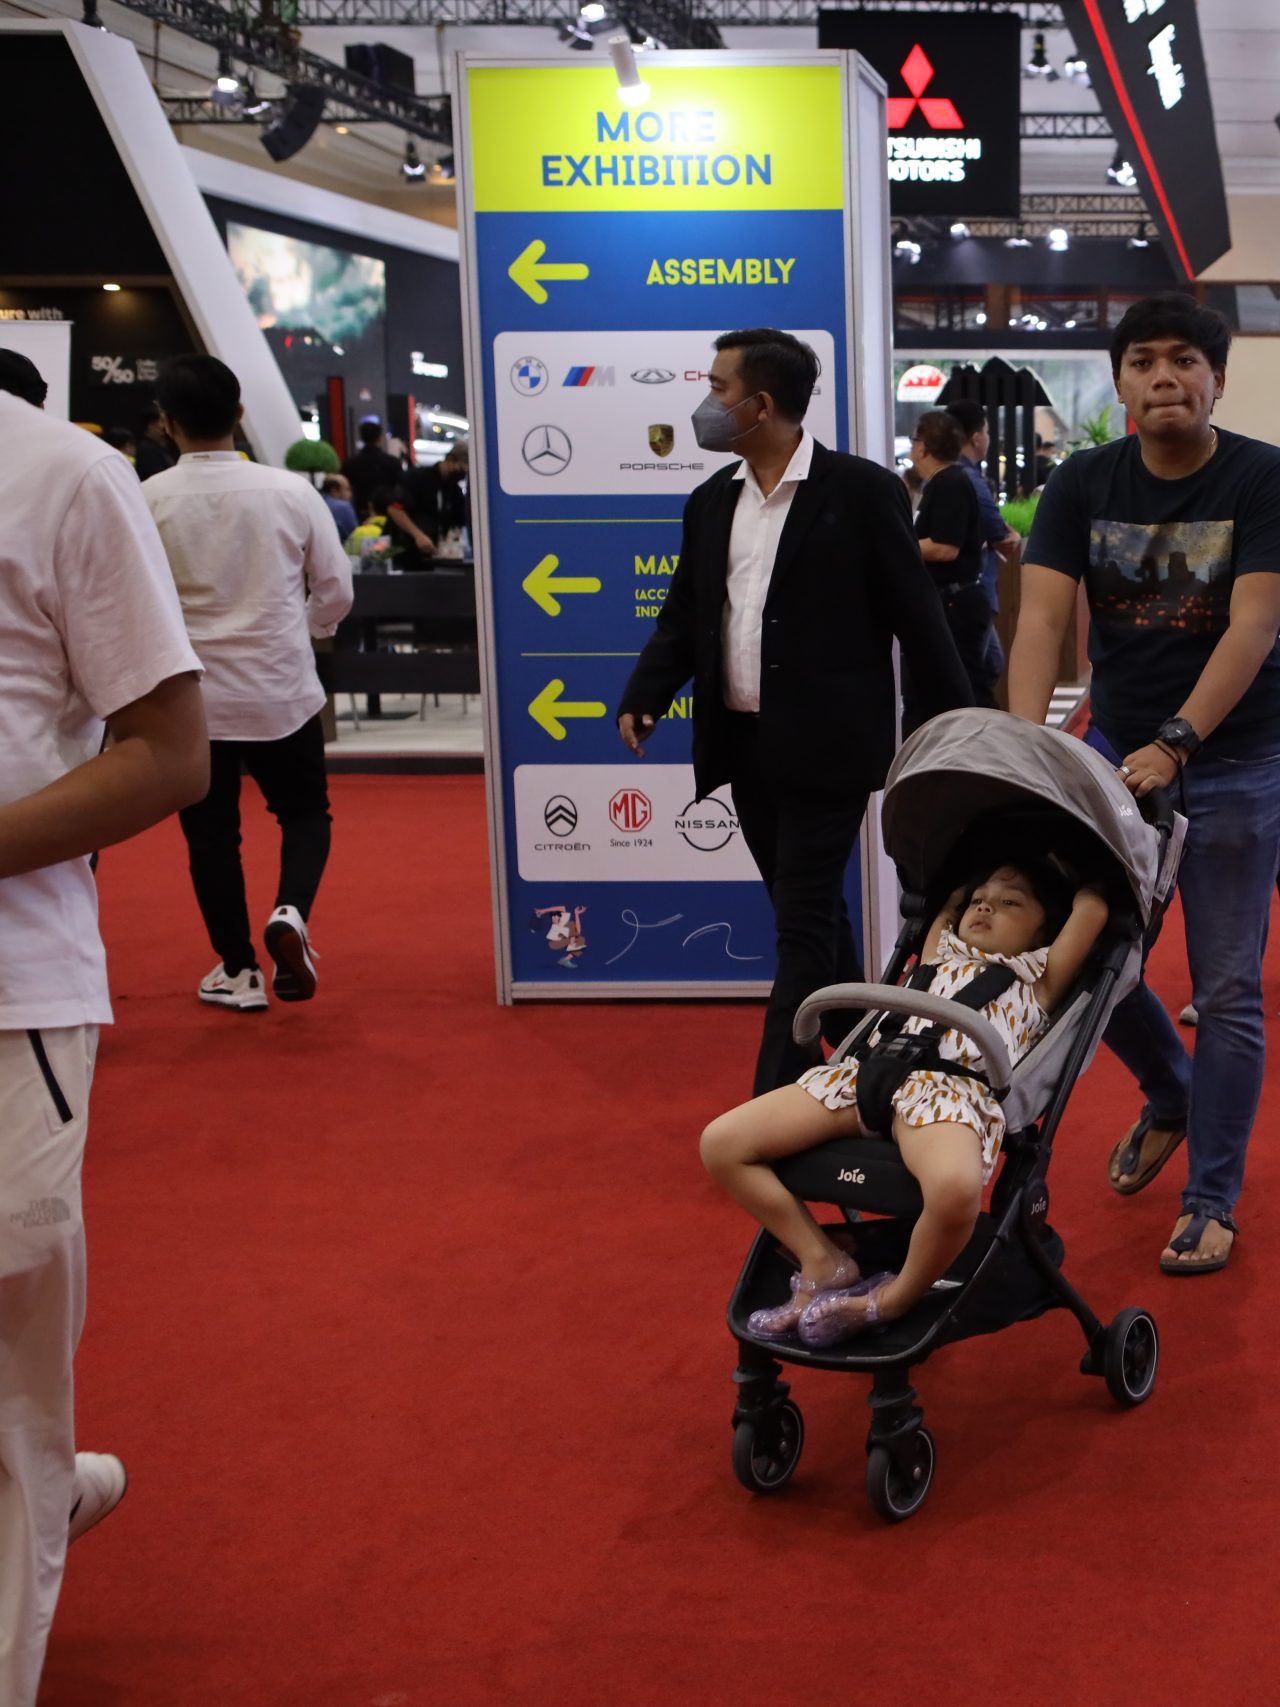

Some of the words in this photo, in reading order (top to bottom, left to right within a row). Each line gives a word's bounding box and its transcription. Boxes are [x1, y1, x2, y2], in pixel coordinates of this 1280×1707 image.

[596, 111, 716, 143] MORE
[887, 137, 981, 159] TSUBISHI
[541, 154, 772, 187] EXHIBITION
[646, 258, 796, 285] ASSEMBLY
[635, 589, 669, 600] (ACC
[635, 606, 663, 617] IND
[675, 820, 740, 829] NISSAN
[610, 839, 630, 847] Since
[634, 838, 653, 847] 1924
[837, 1168, 866, 1184] Joie
